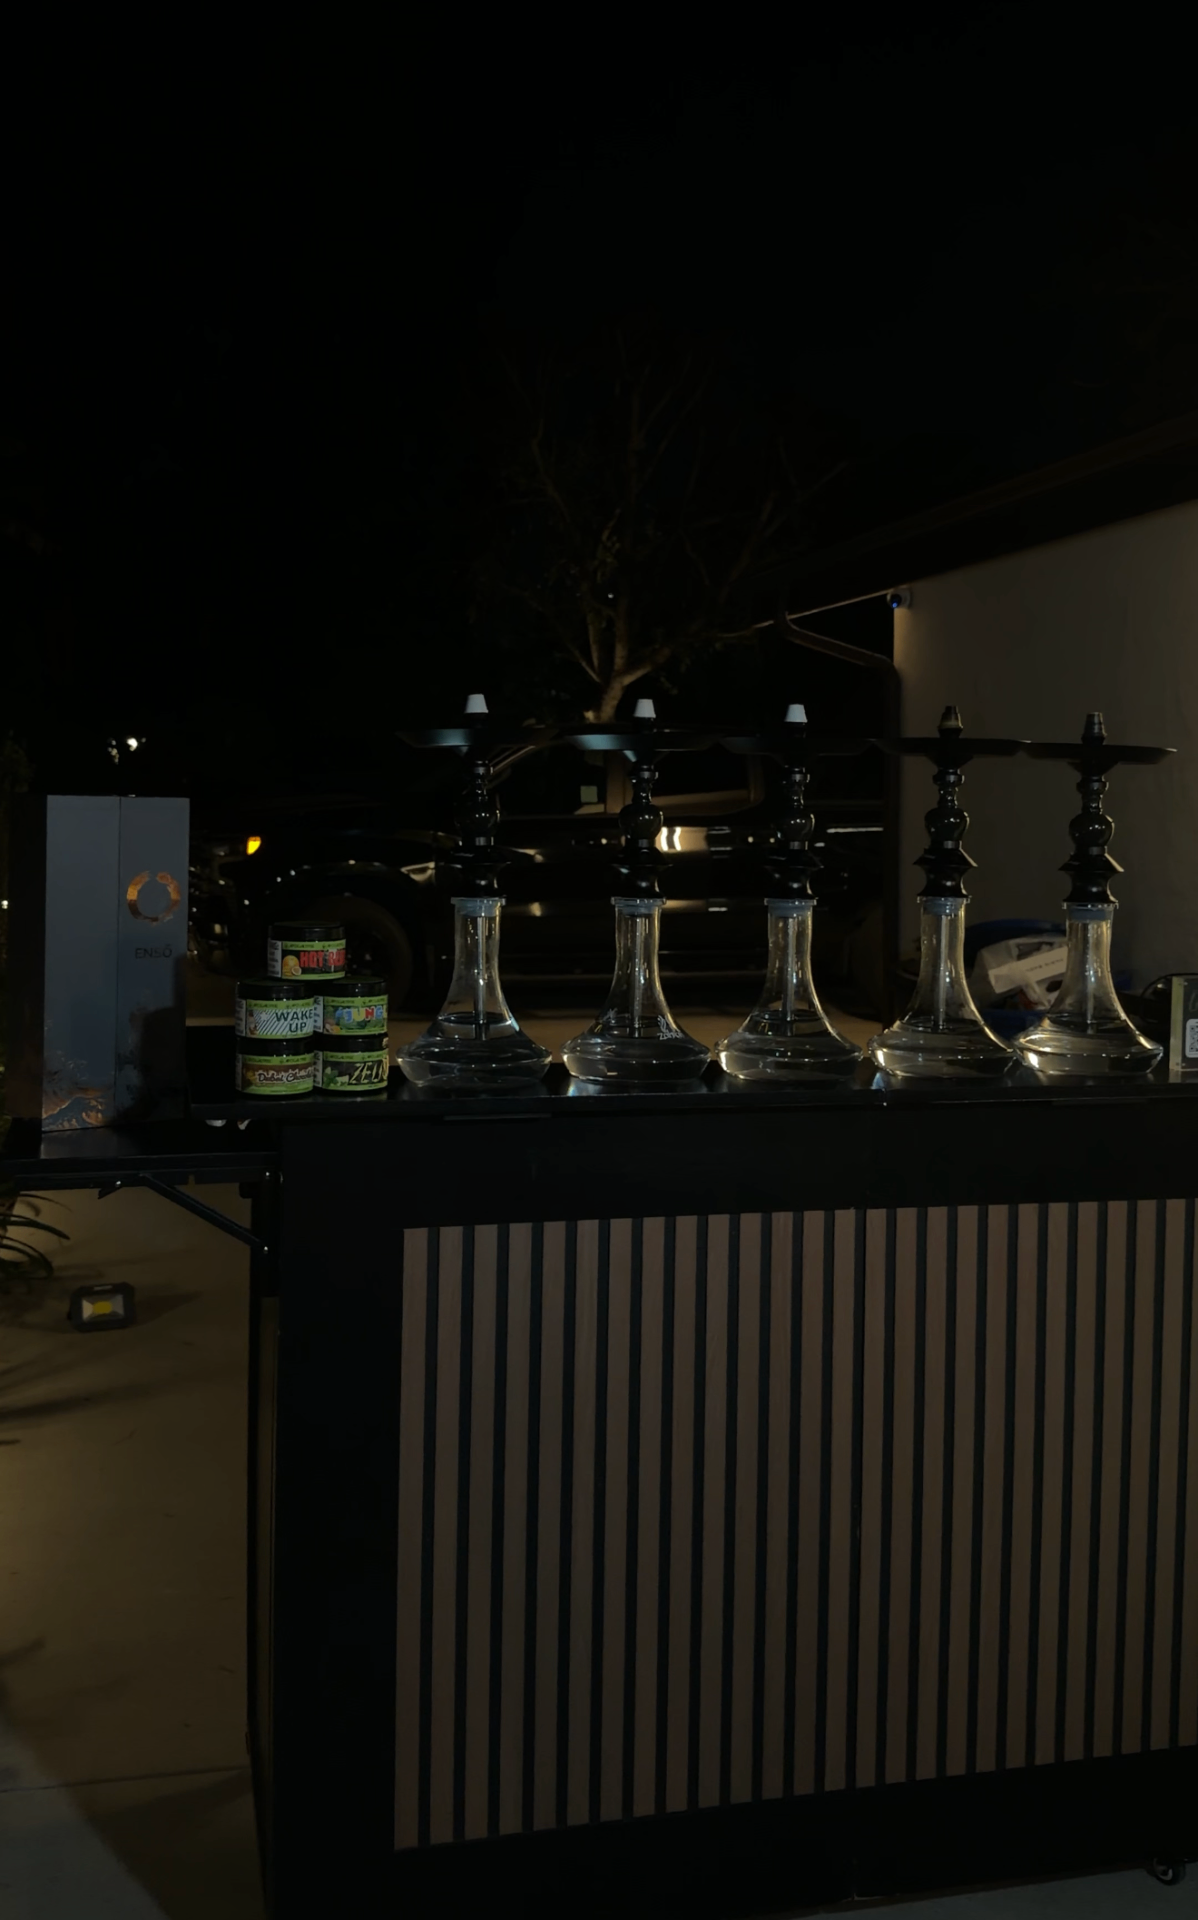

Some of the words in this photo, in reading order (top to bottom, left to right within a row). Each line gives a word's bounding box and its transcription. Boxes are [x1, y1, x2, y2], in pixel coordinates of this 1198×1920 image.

[299, 951, 324, 968] HOT
[275, 1009, 314, 1022] WAKE
[289, 1022, 307, 1033] UP
